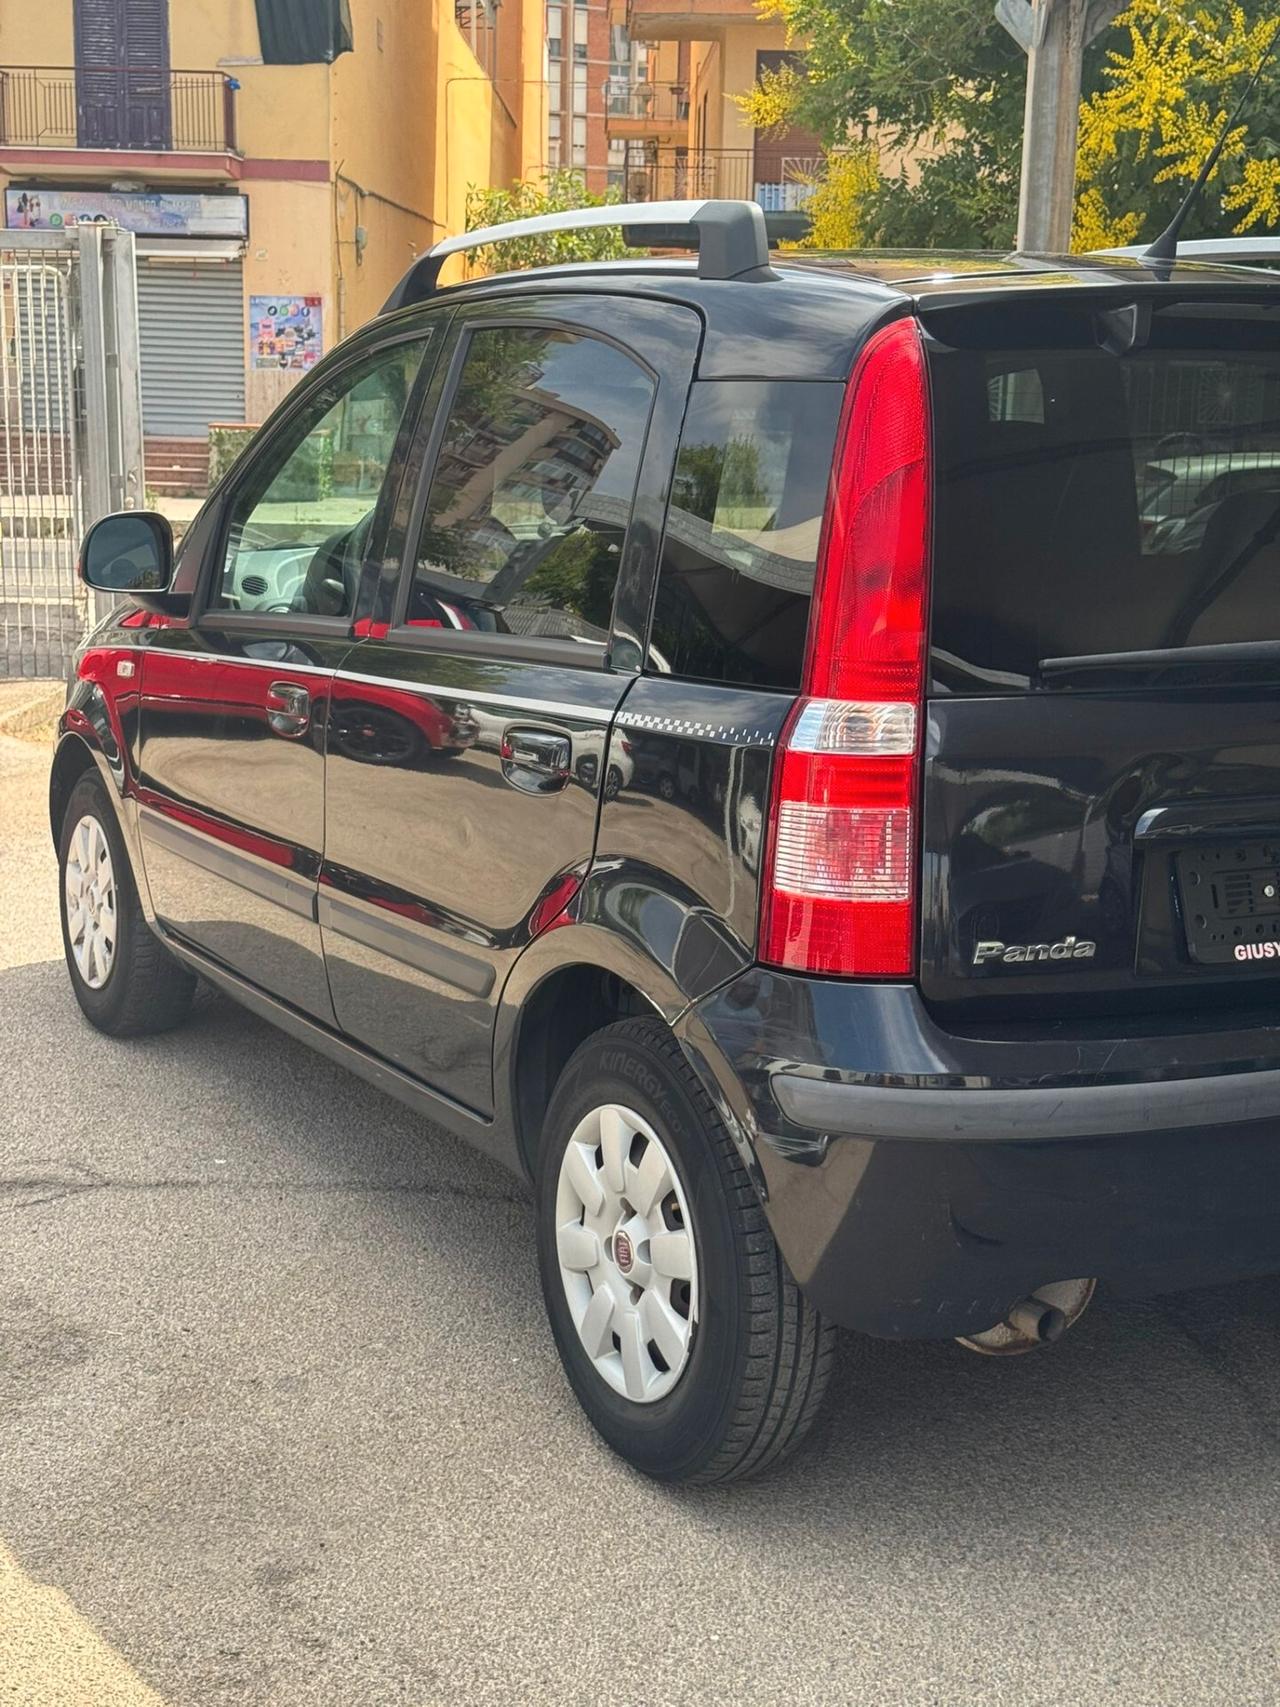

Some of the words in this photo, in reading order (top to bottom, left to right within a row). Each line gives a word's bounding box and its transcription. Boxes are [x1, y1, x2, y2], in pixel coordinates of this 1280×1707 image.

[973, 936, 1096, 965] Panda
[599, 1050, 667, 1099] KINERGY
[617, 1240, 630, 1264] FIAT
